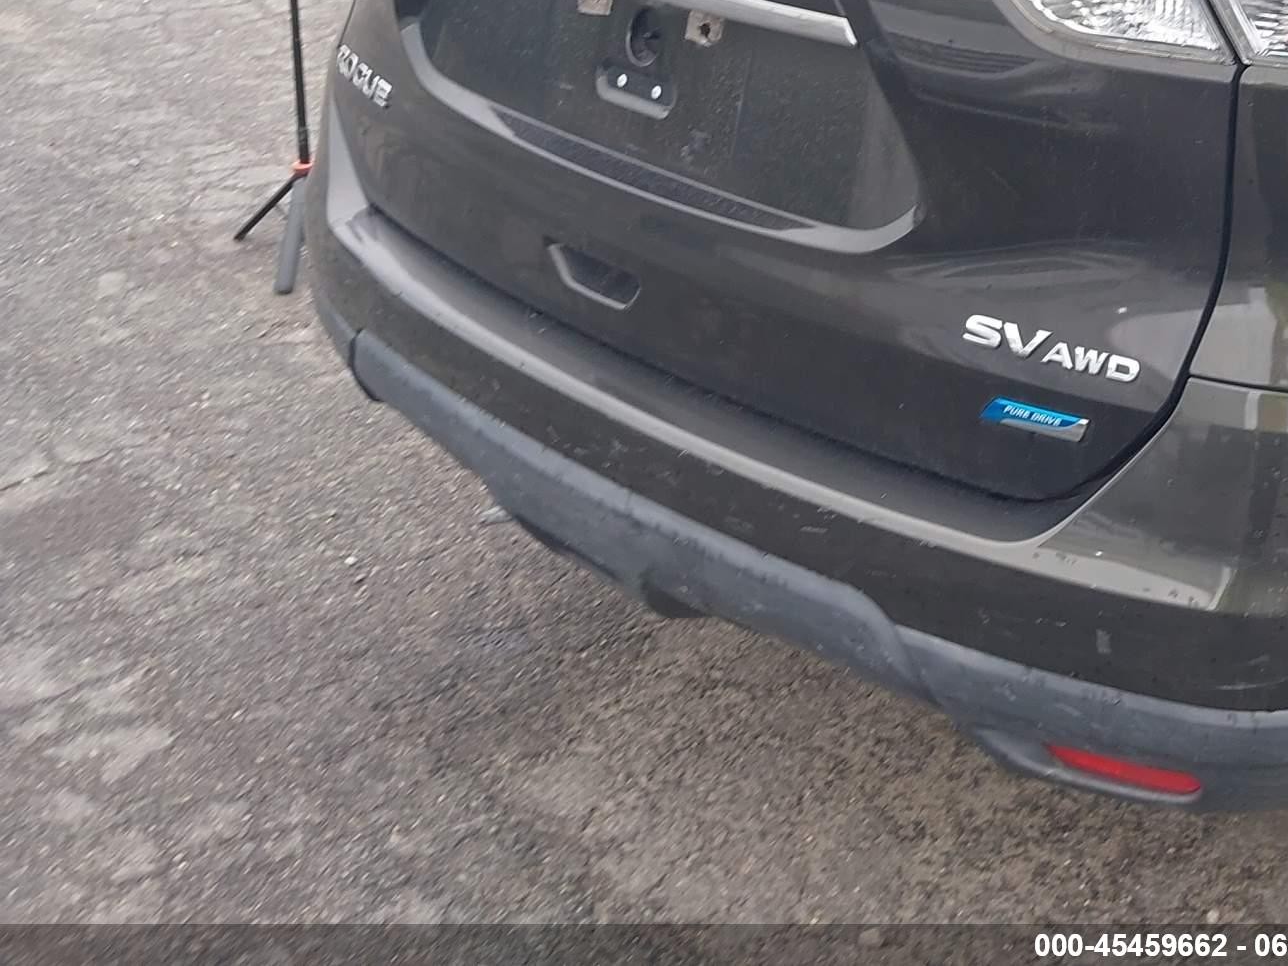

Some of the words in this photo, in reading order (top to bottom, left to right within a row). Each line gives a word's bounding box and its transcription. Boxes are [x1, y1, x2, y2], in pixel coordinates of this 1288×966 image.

[962, 314, 1053, 358] SV
[1040, 342, 1141, 382] AWD
[1003, 405, 1031, 419] PURE
[1030, 411, 1063, 427] DRIVE
